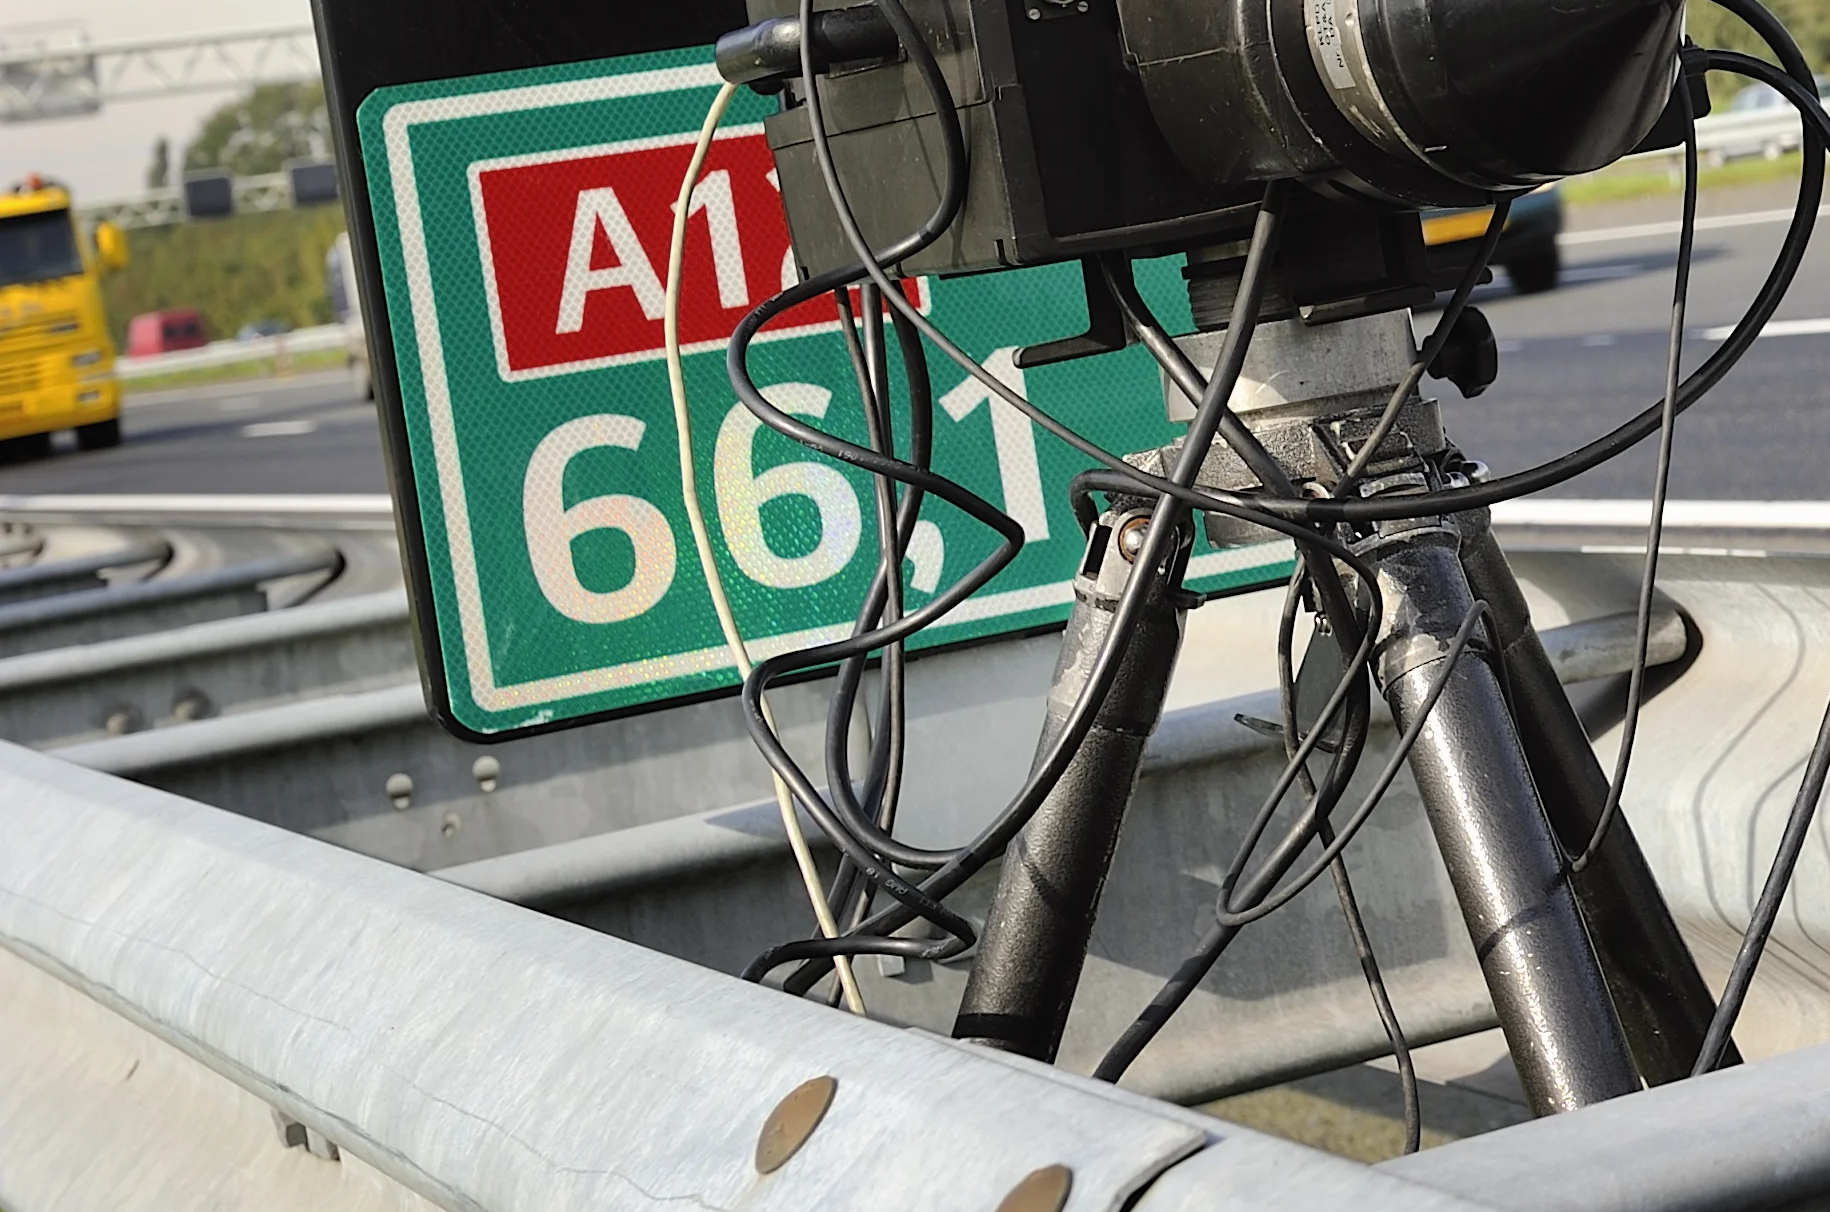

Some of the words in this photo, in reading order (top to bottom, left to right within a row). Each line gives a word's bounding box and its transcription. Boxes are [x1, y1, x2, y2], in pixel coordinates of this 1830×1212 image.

[1314, 3, 1325, 46] KLPD
[555, 167, 800, 335] A1
[522, 346, 1051, 624] 66,1
